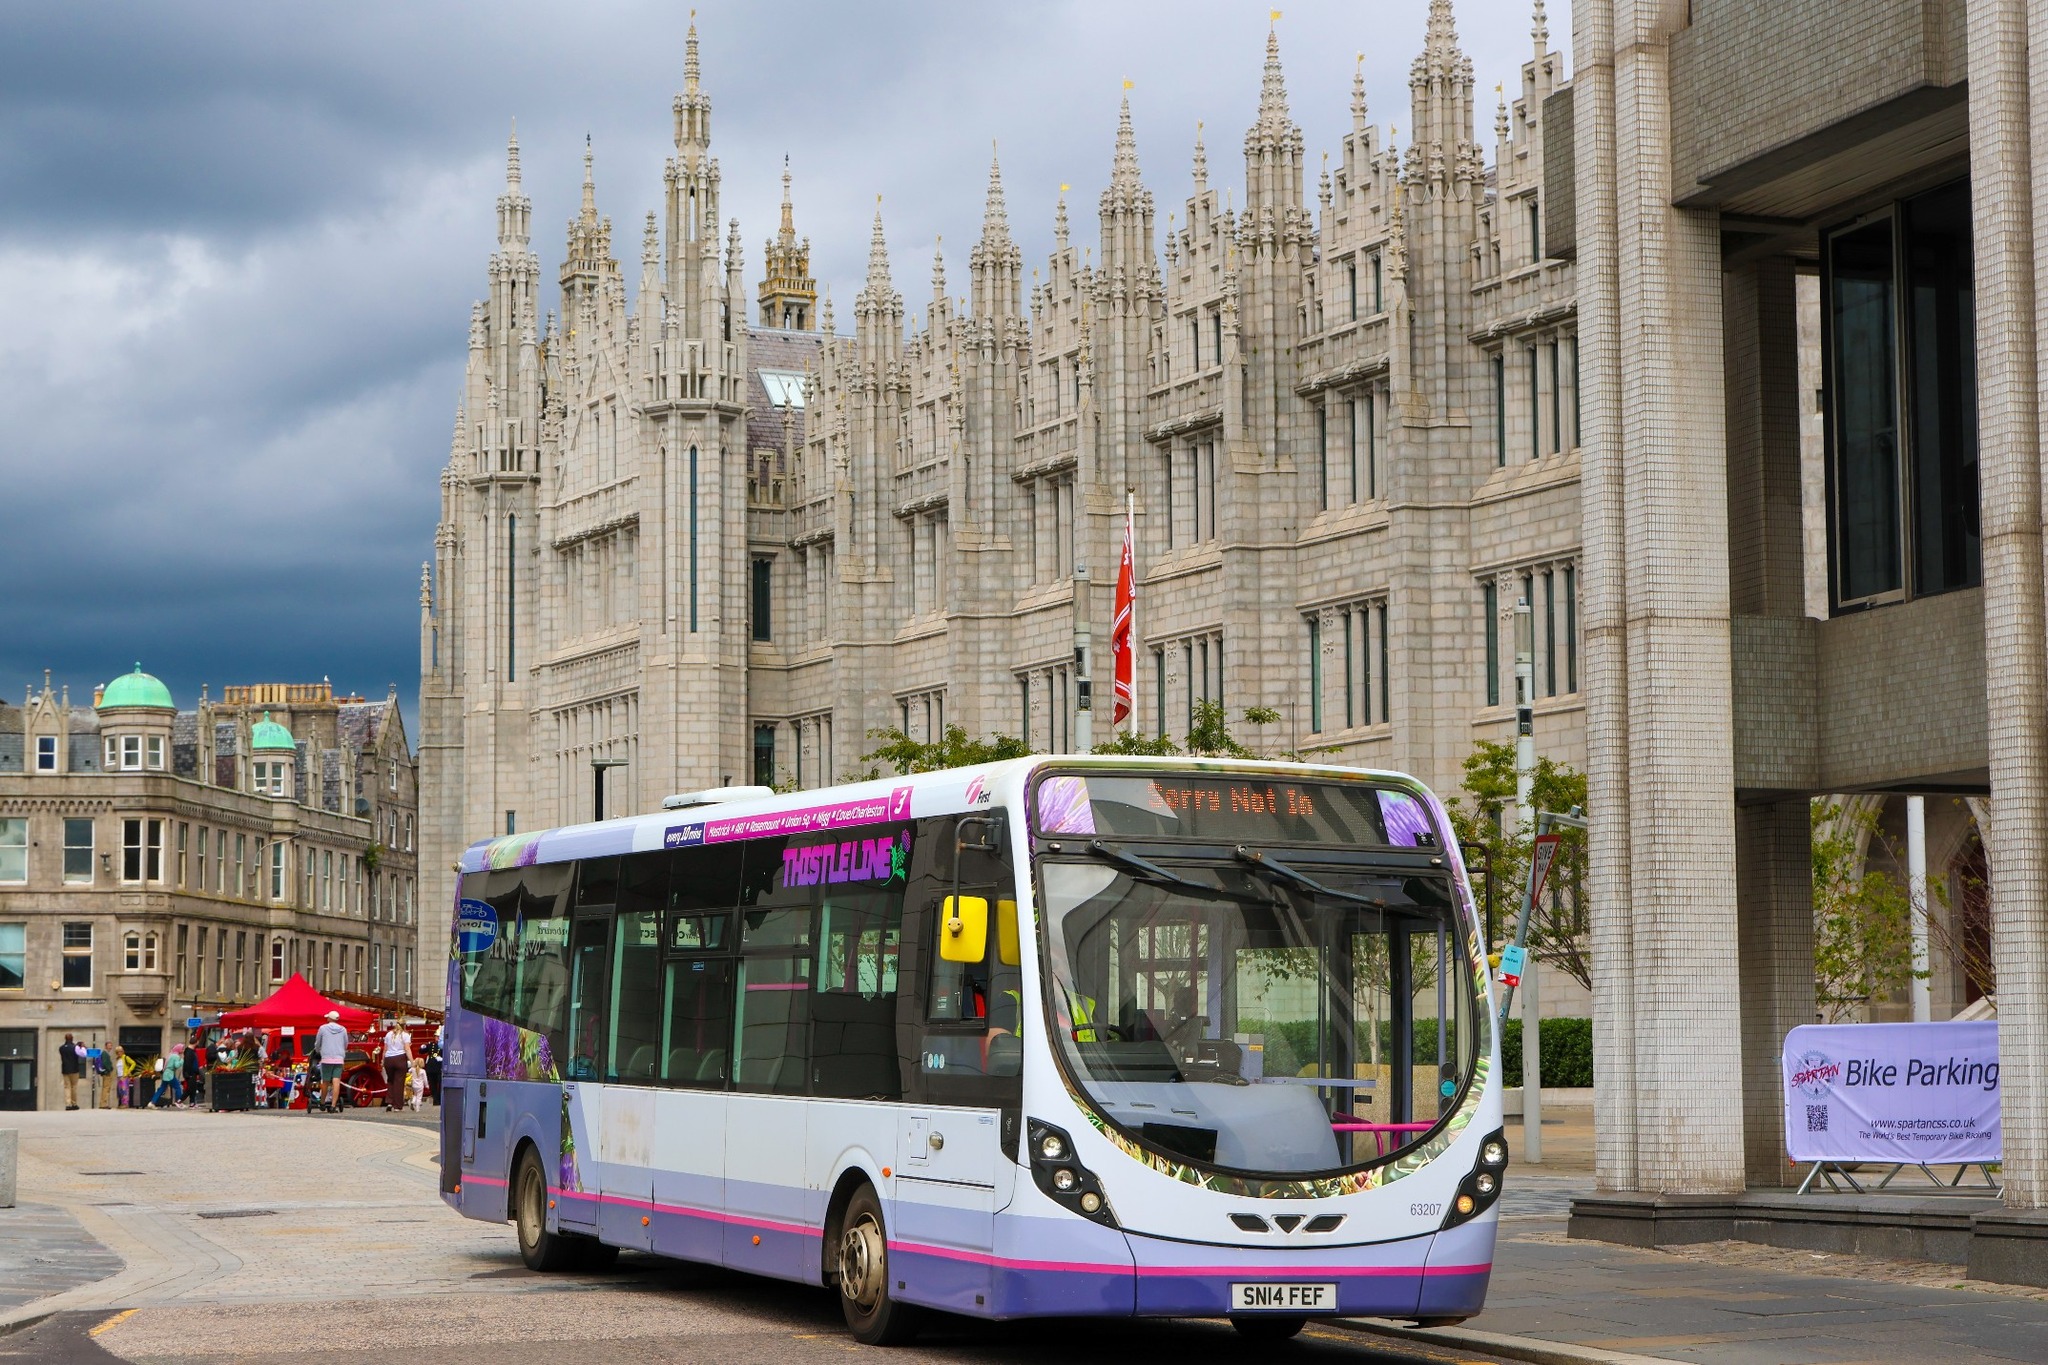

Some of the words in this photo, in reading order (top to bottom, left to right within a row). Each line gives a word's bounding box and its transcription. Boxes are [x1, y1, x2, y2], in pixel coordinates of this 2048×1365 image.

[894, 789, 908, 814] 3
[977, 790, 991, 803] First
[1148, 782, 1220, 811] Sorry
[1230, 787, 1277, 813] Not
[1287, 789, 1313, 815] In
[708, 823, 731, 838] Mastrick
[749, 817, 780, 832] Rosemount
[785, 814, 802, 828] Union
[816, 811, 831, 827] Nigg
[836, 804, 885, 821] Cove/Charleston
[666, 832, 682, 845] every
[680, 825, 691, 841] 10
[688, 827, 702, 840] mins
[1538, 845, 1552, 859] GIVE
[1791, 1062, 1841, 1088] SPARTAN
[1846, 1058, 1897, 1087] Bike
[1906, 1056, 2000, 1092] Parking
[1870, 1116, 1976, 1131] www.spartancss.co.uk
[1859, 1130, 1871, 1139] The
[1872, 1131, 1895, 1140] World's
[1896, 1132, 1911, 1141] Best
[1912, 1132, 1948, 1142] Temporary
[1949, 1131, 1964, 1141] Bike
[1965, 1131, 1992, 1140] Racking
[1410, 1203, 1442, 1216] 63207
[1243, 1286, 1284, 1306] SN14
[1289, 1286, 1325, 1306] FEF
